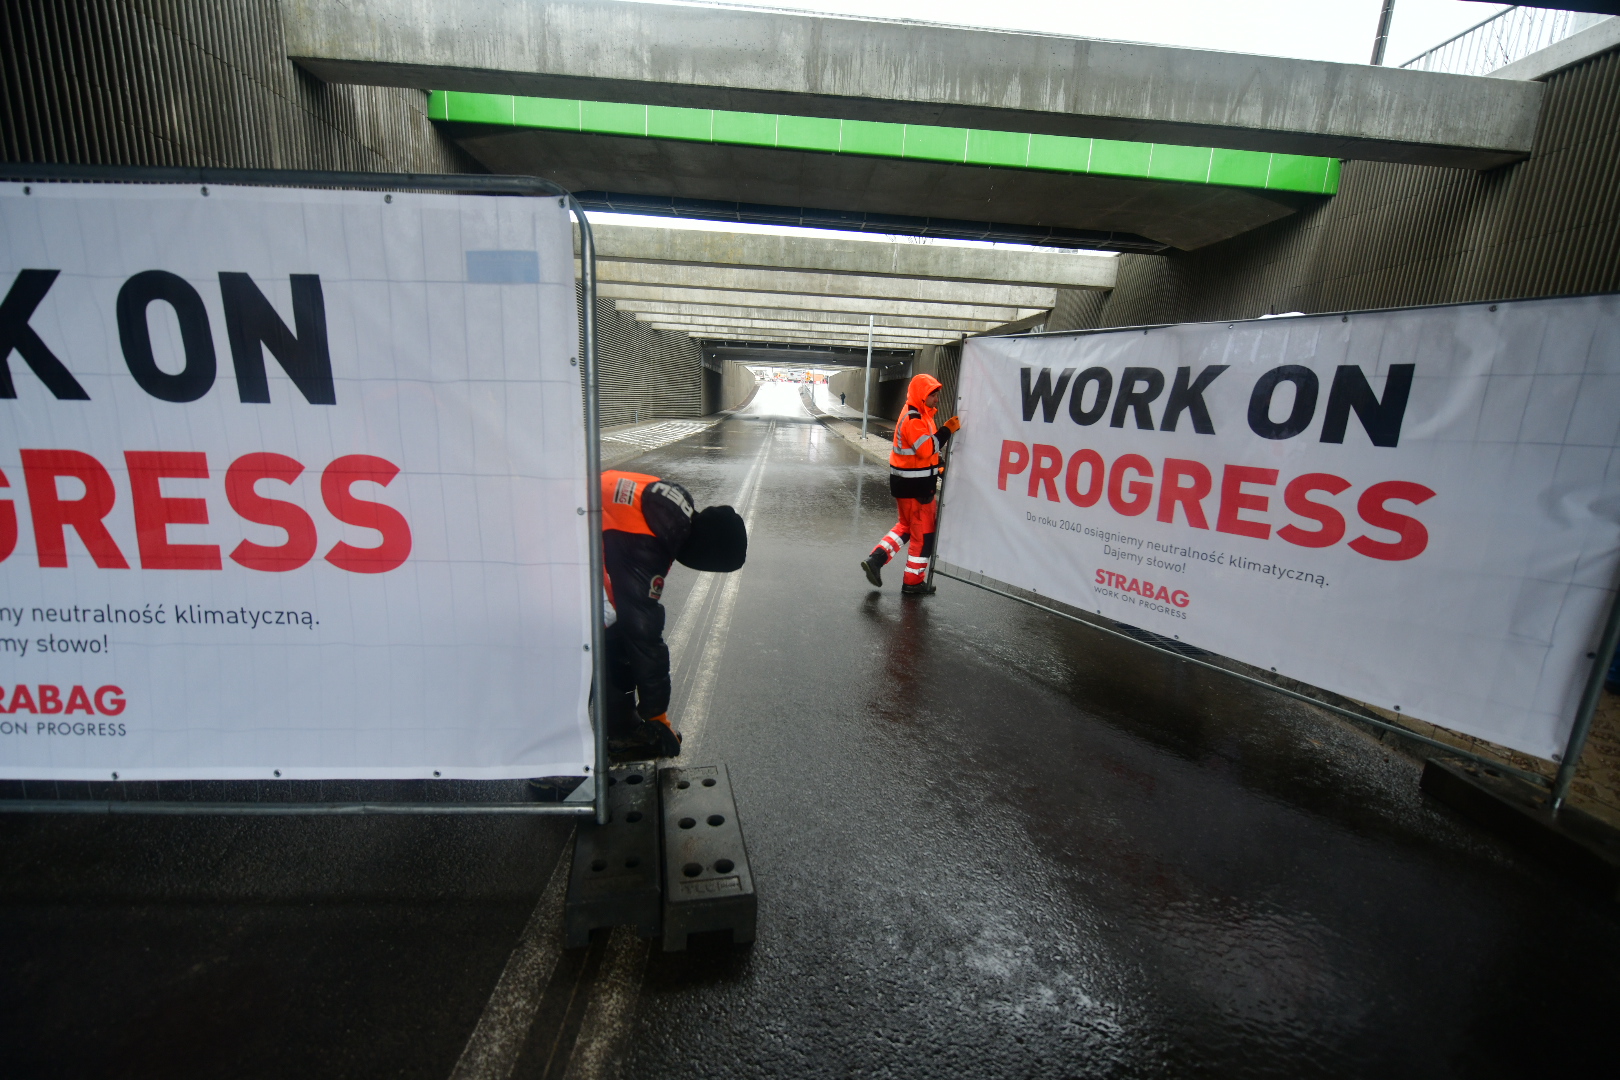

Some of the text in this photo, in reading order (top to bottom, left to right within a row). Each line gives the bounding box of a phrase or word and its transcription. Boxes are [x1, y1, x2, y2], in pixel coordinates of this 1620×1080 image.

[116, 269, 337, 406] ON
[1019, 362, 1416, 448] WORK ON
[0, 448, 413, 575] RESS
[997, 439, 1437, 562] PROGRESS
[1026, 511, 1330, 588] Do roku 2040 osiągniemy neutralność klimatyczną.
[1103, 544, 1186, 574] Dajemy słowo!
[1093, 585, 1187, 620] WORK ON PROGRESS
[1095, 568, 1190, 608] STRABAG
[32, 603, 166, 624] neutralność
[175, 604, 320, 630] klimatyczną.
[36, 633, 108, 653] słowo!
[0, 684, 127, 717] ABAG
[0, 721, 127, 737] ON PROGRESS
